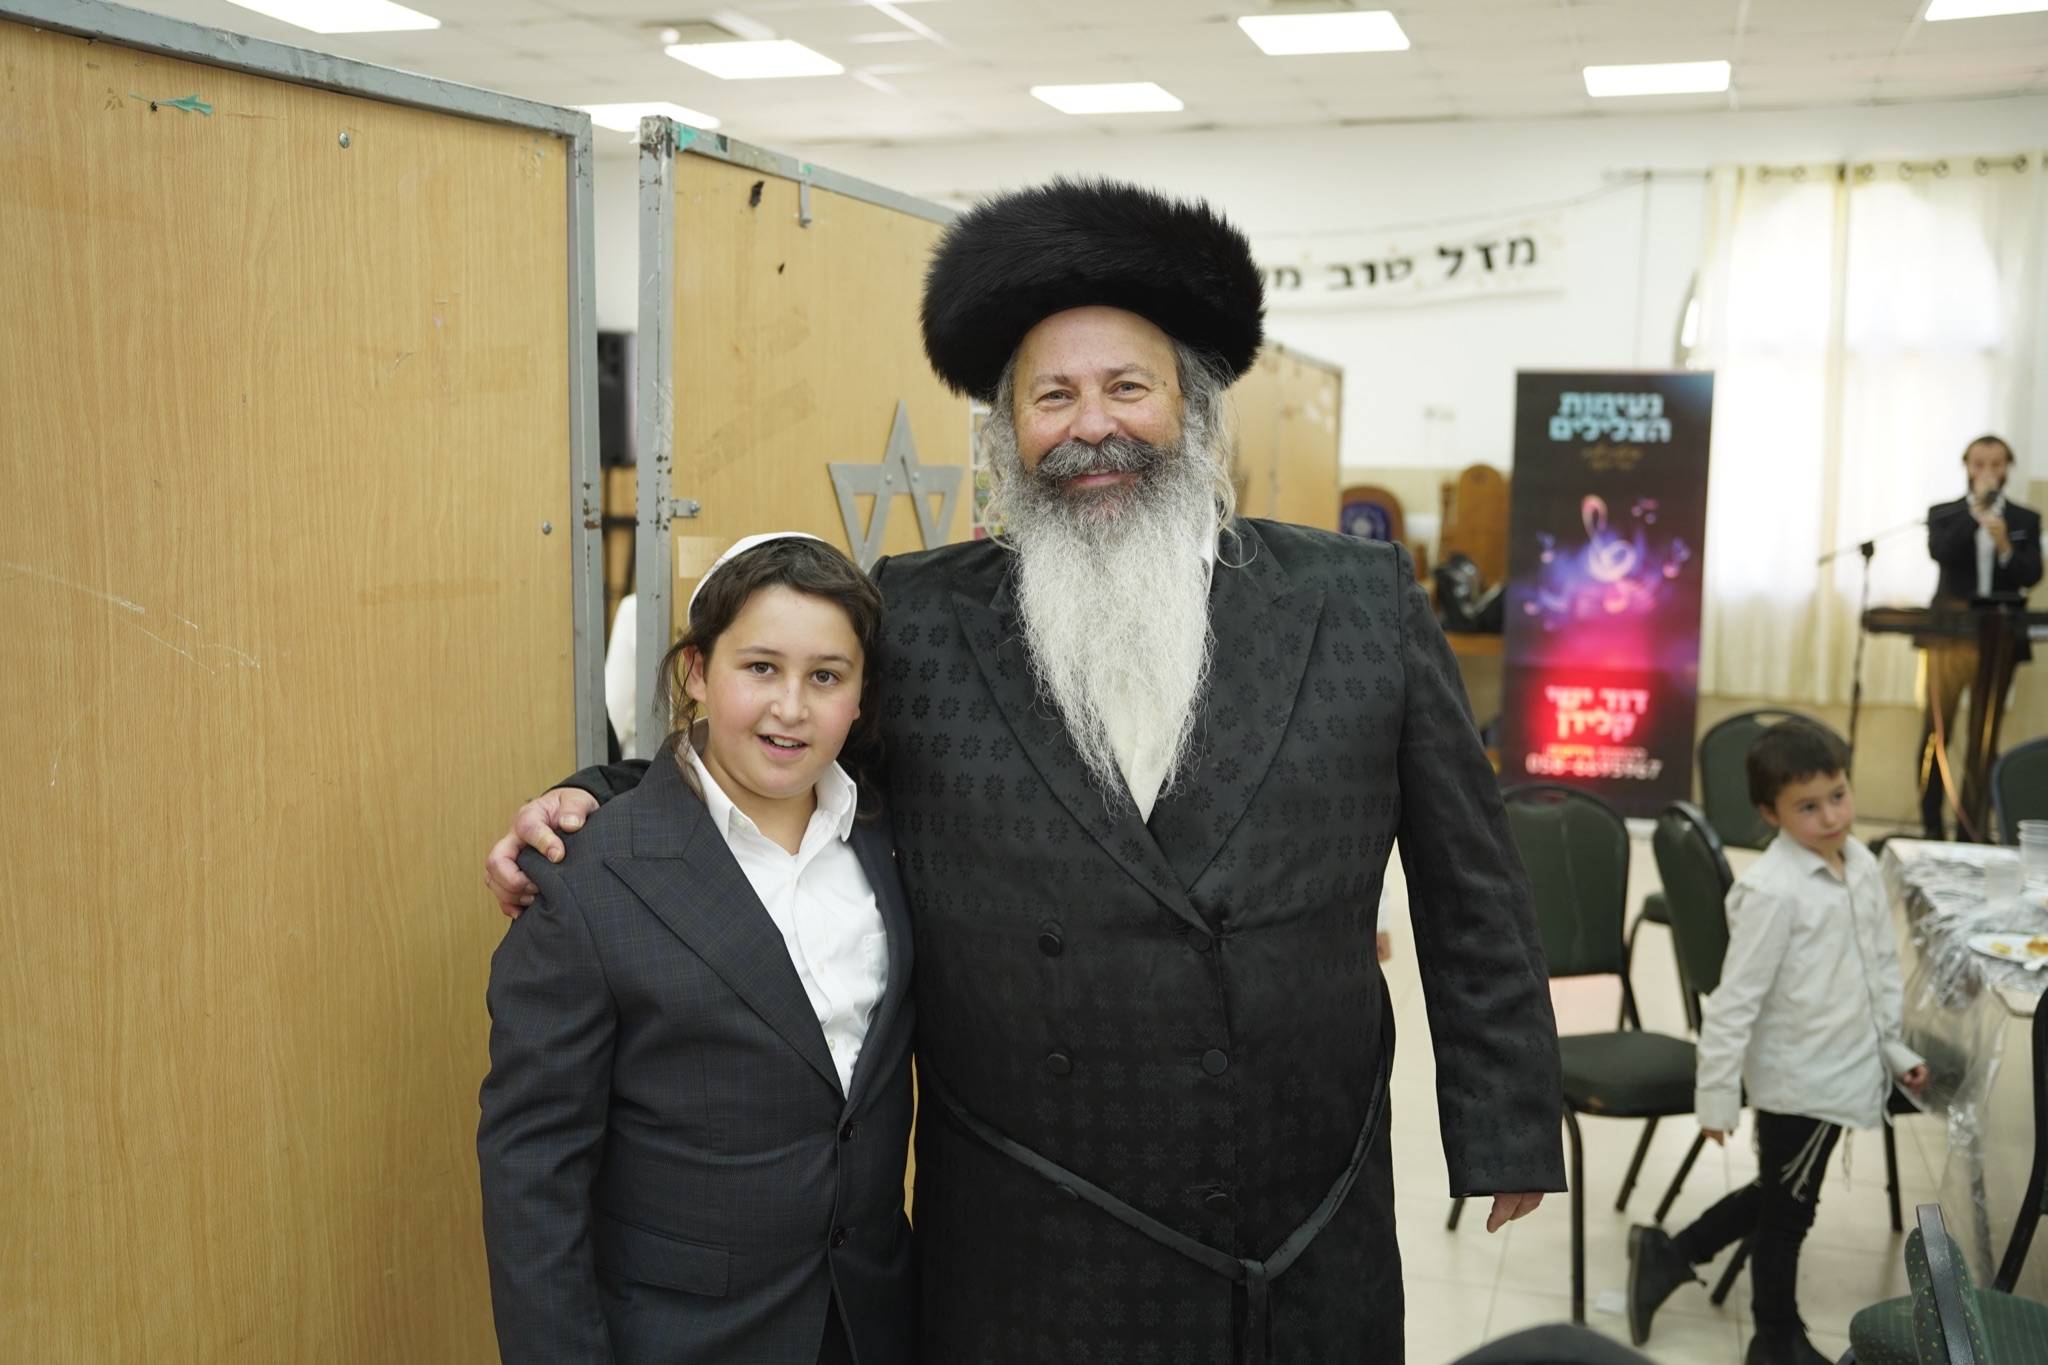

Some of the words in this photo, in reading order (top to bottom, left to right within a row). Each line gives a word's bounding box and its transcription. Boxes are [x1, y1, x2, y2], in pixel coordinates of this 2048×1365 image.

[1435, 235, 1537, 279] מזל
[1326, 256, 1414, 290] טוב
[1558, 391, 1664, 418] נעימות
[1549, 414, 1672, 442] הצלילים
[1599, 687, 1649, 714] דוד
